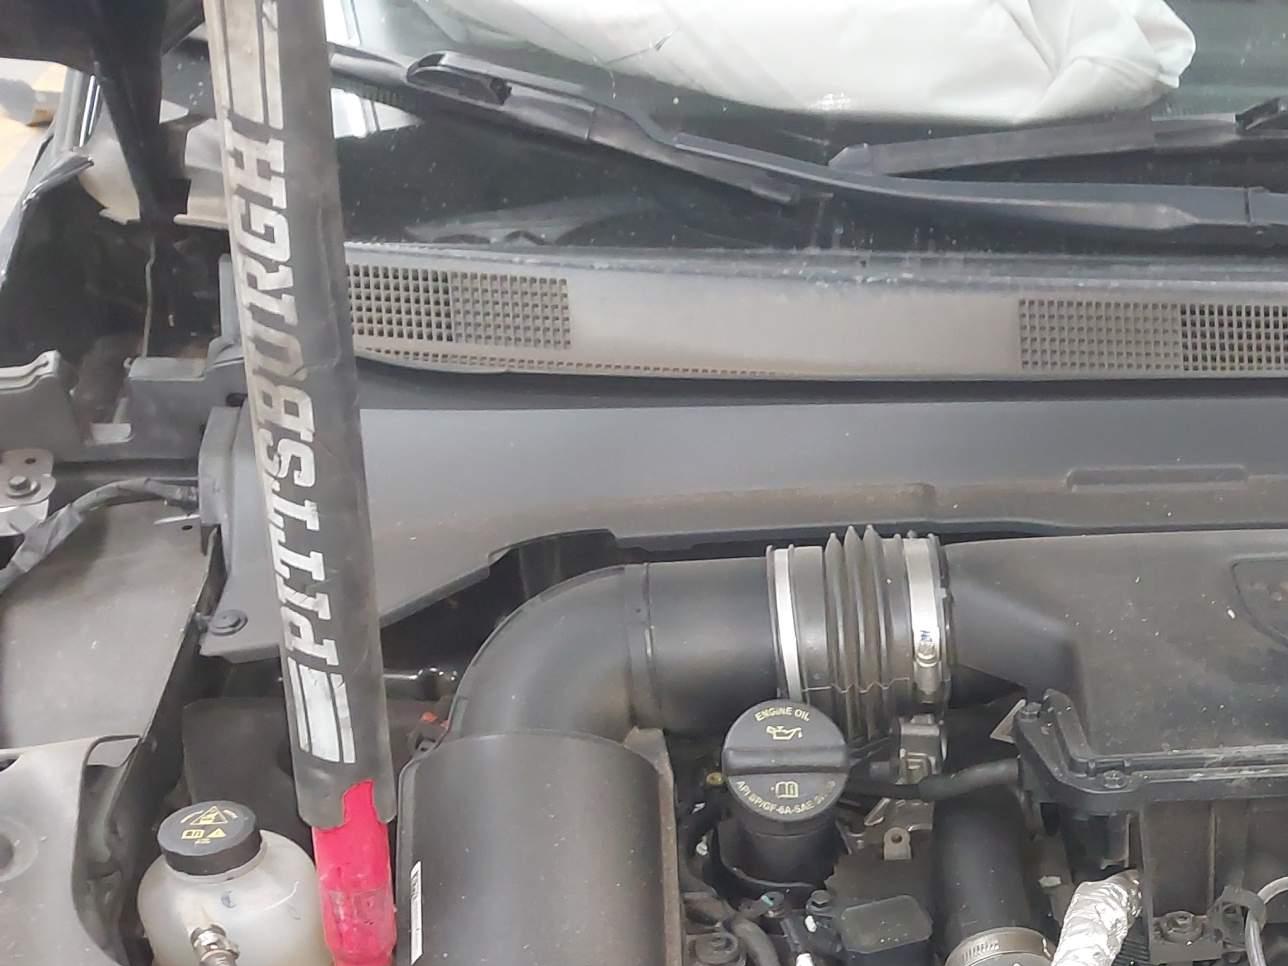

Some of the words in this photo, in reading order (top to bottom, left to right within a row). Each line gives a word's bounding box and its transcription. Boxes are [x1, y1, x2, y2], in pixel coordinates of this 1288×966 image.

[226, 135, 340, 667] PITTSBURGH
[755, 706, 793, 722] ENGINE
[794, 709, 811, 722] OIL
[737, 781, 750, 797] API
